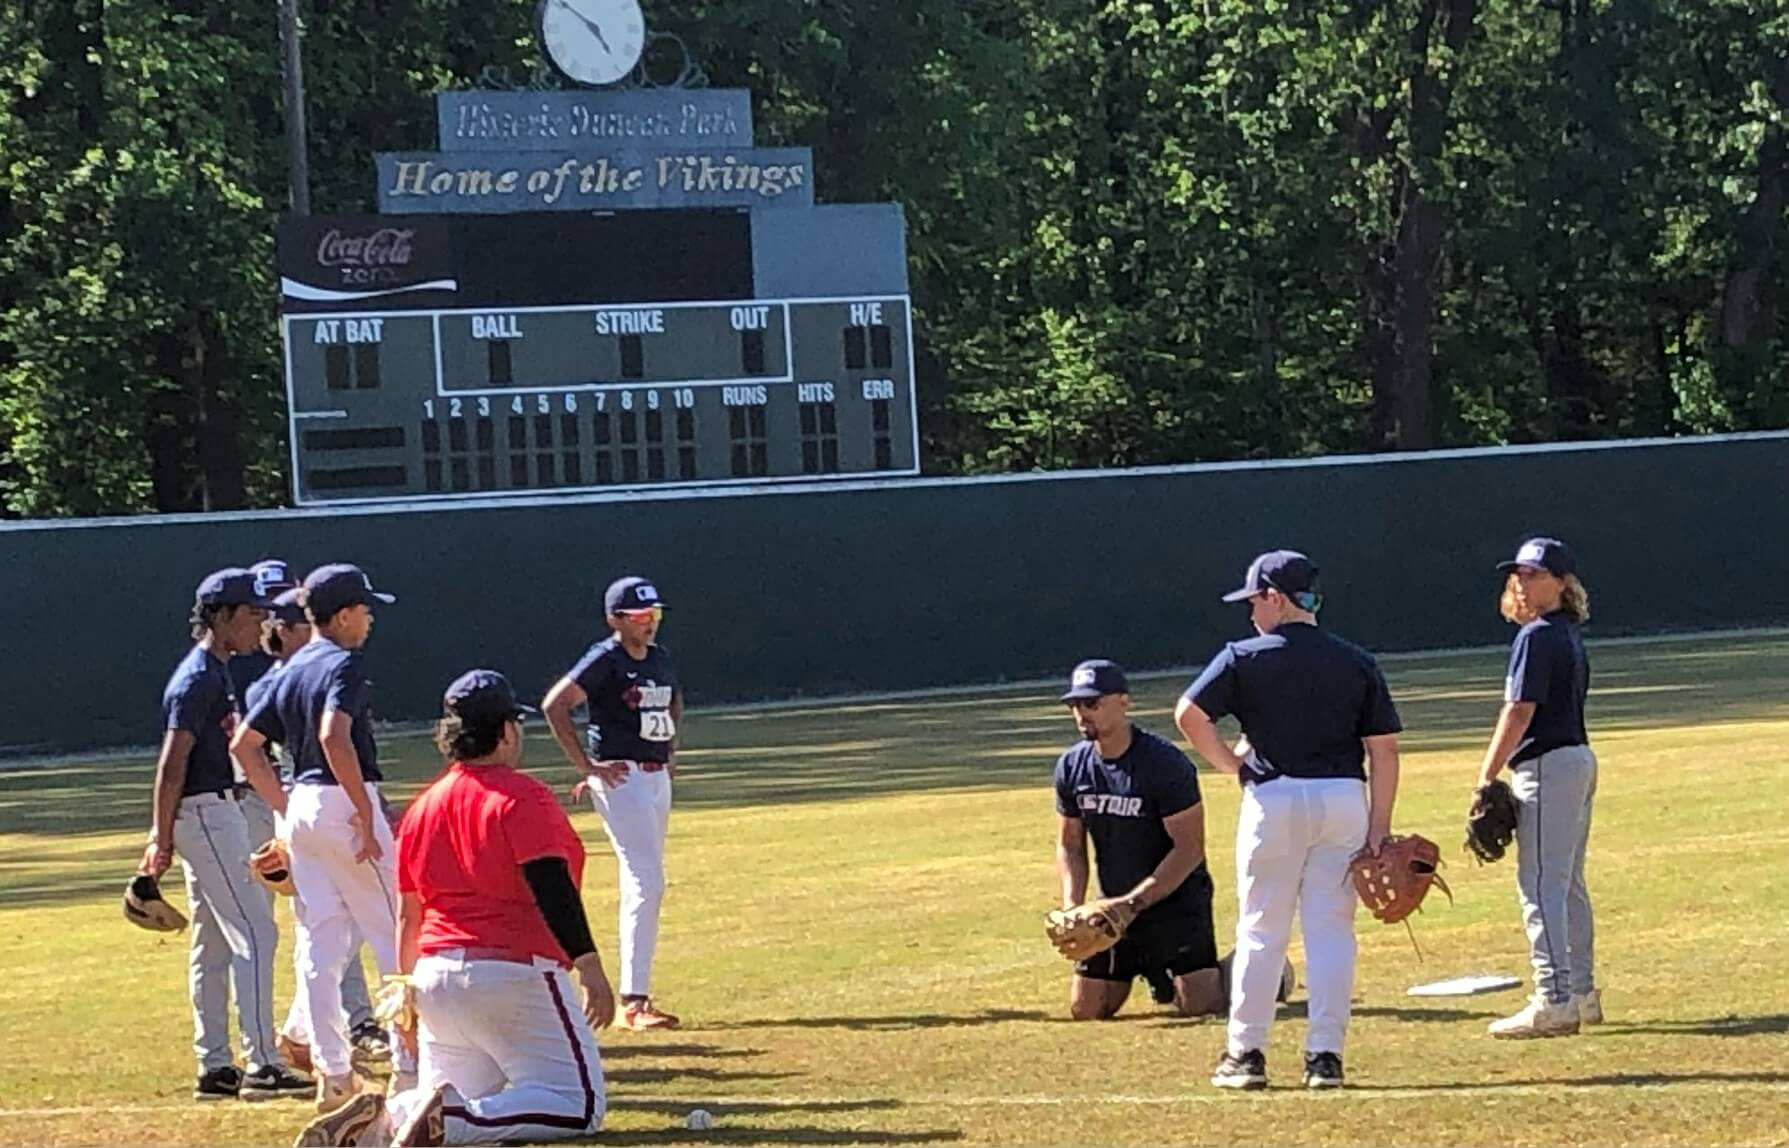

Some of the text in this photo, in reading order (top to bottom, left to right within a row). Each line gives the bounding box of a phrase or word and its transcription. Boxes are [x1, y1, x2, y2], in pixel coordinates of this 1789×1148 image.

[679, 103, 738, 136] Park
[388, 155, 804, 203] Home of the Vikings
[595, 310, 665, 334] STRIKE
[731, 306, 769, 330] OUT
[850, 302, 883, 326] H/E
[314, 319, 384, 344] AT BAT
[472, 315, 524, 338] BALL
[424, 379, 895, 418] 1 2 3 4 5 6 7 8 9 10 RUNS HITS ERR
[649, 715, 670, 737] 21
